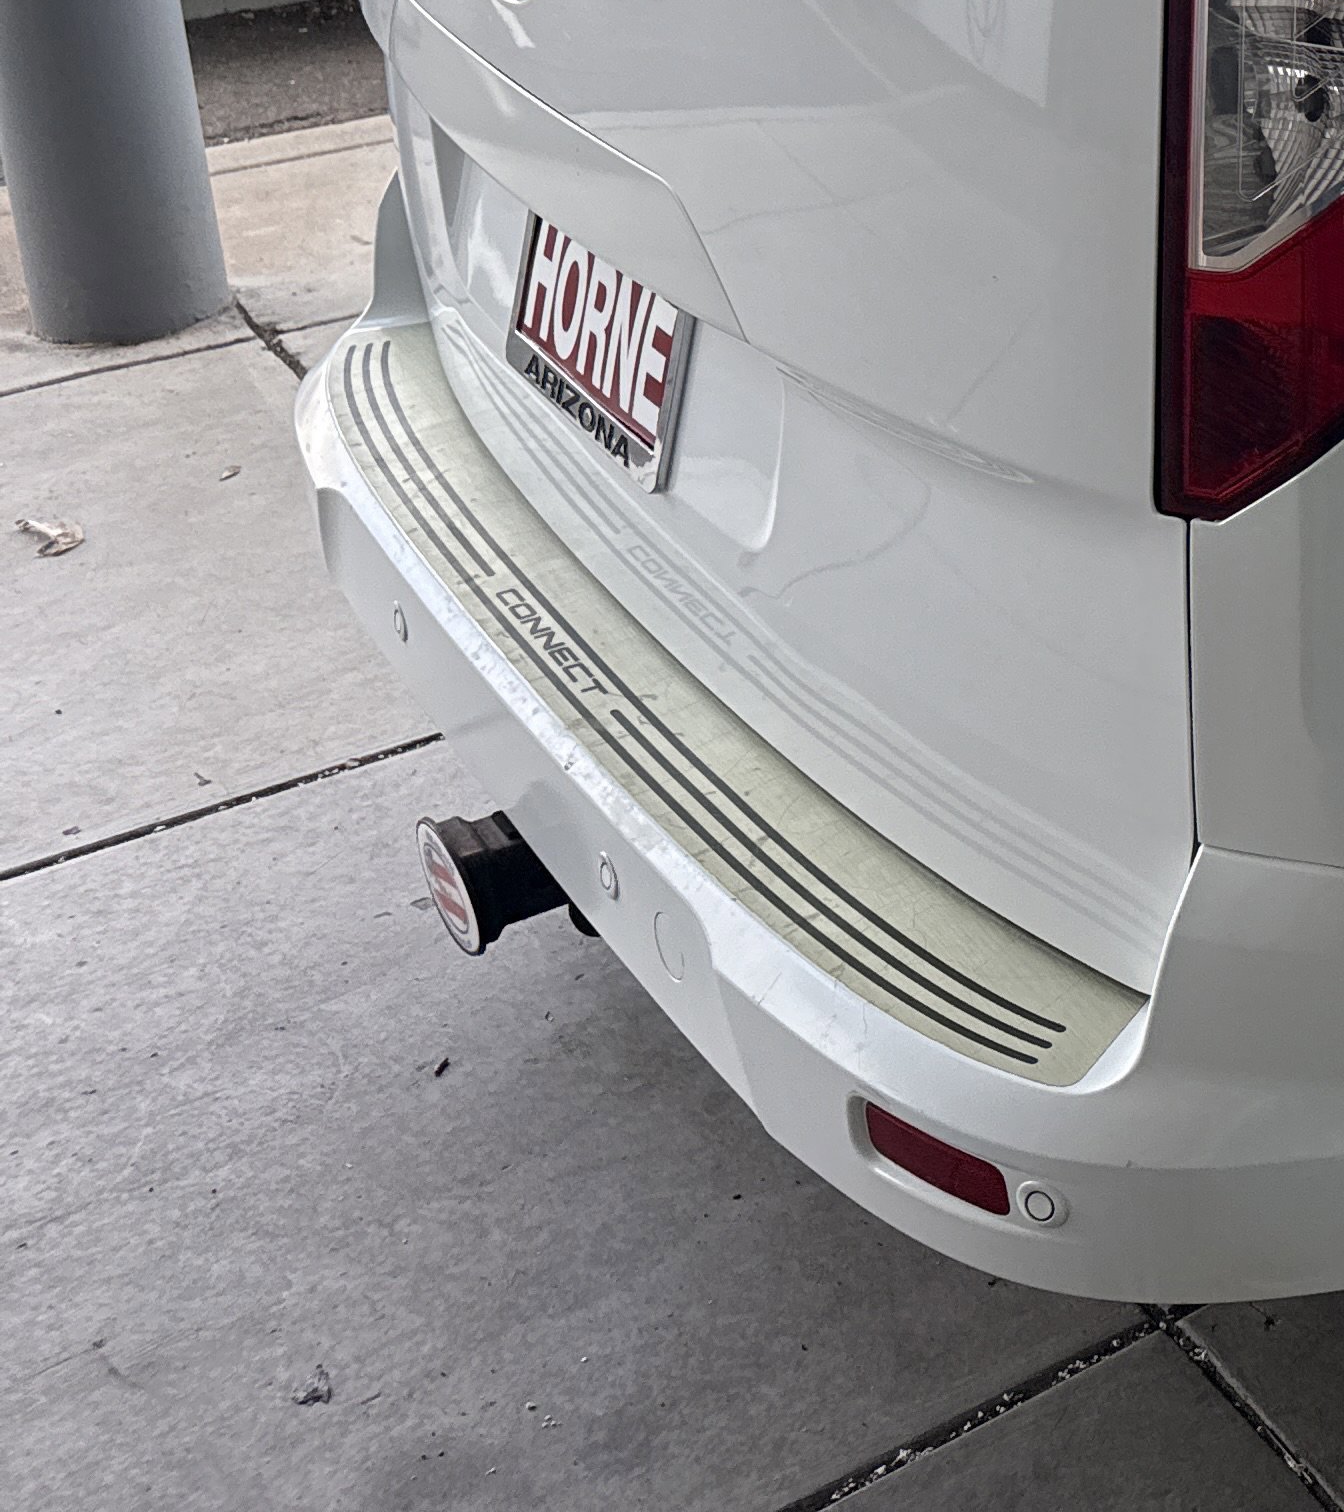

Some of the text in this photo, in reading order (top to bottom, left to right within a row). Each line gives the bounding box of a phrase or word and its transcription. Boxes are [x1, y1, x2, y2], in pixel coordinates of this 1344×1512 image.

[523, 219, 678, 438] HORNE
[524, 354, 631, 469] ARIZONA
[495, 587, 609, 695] CONNECT
